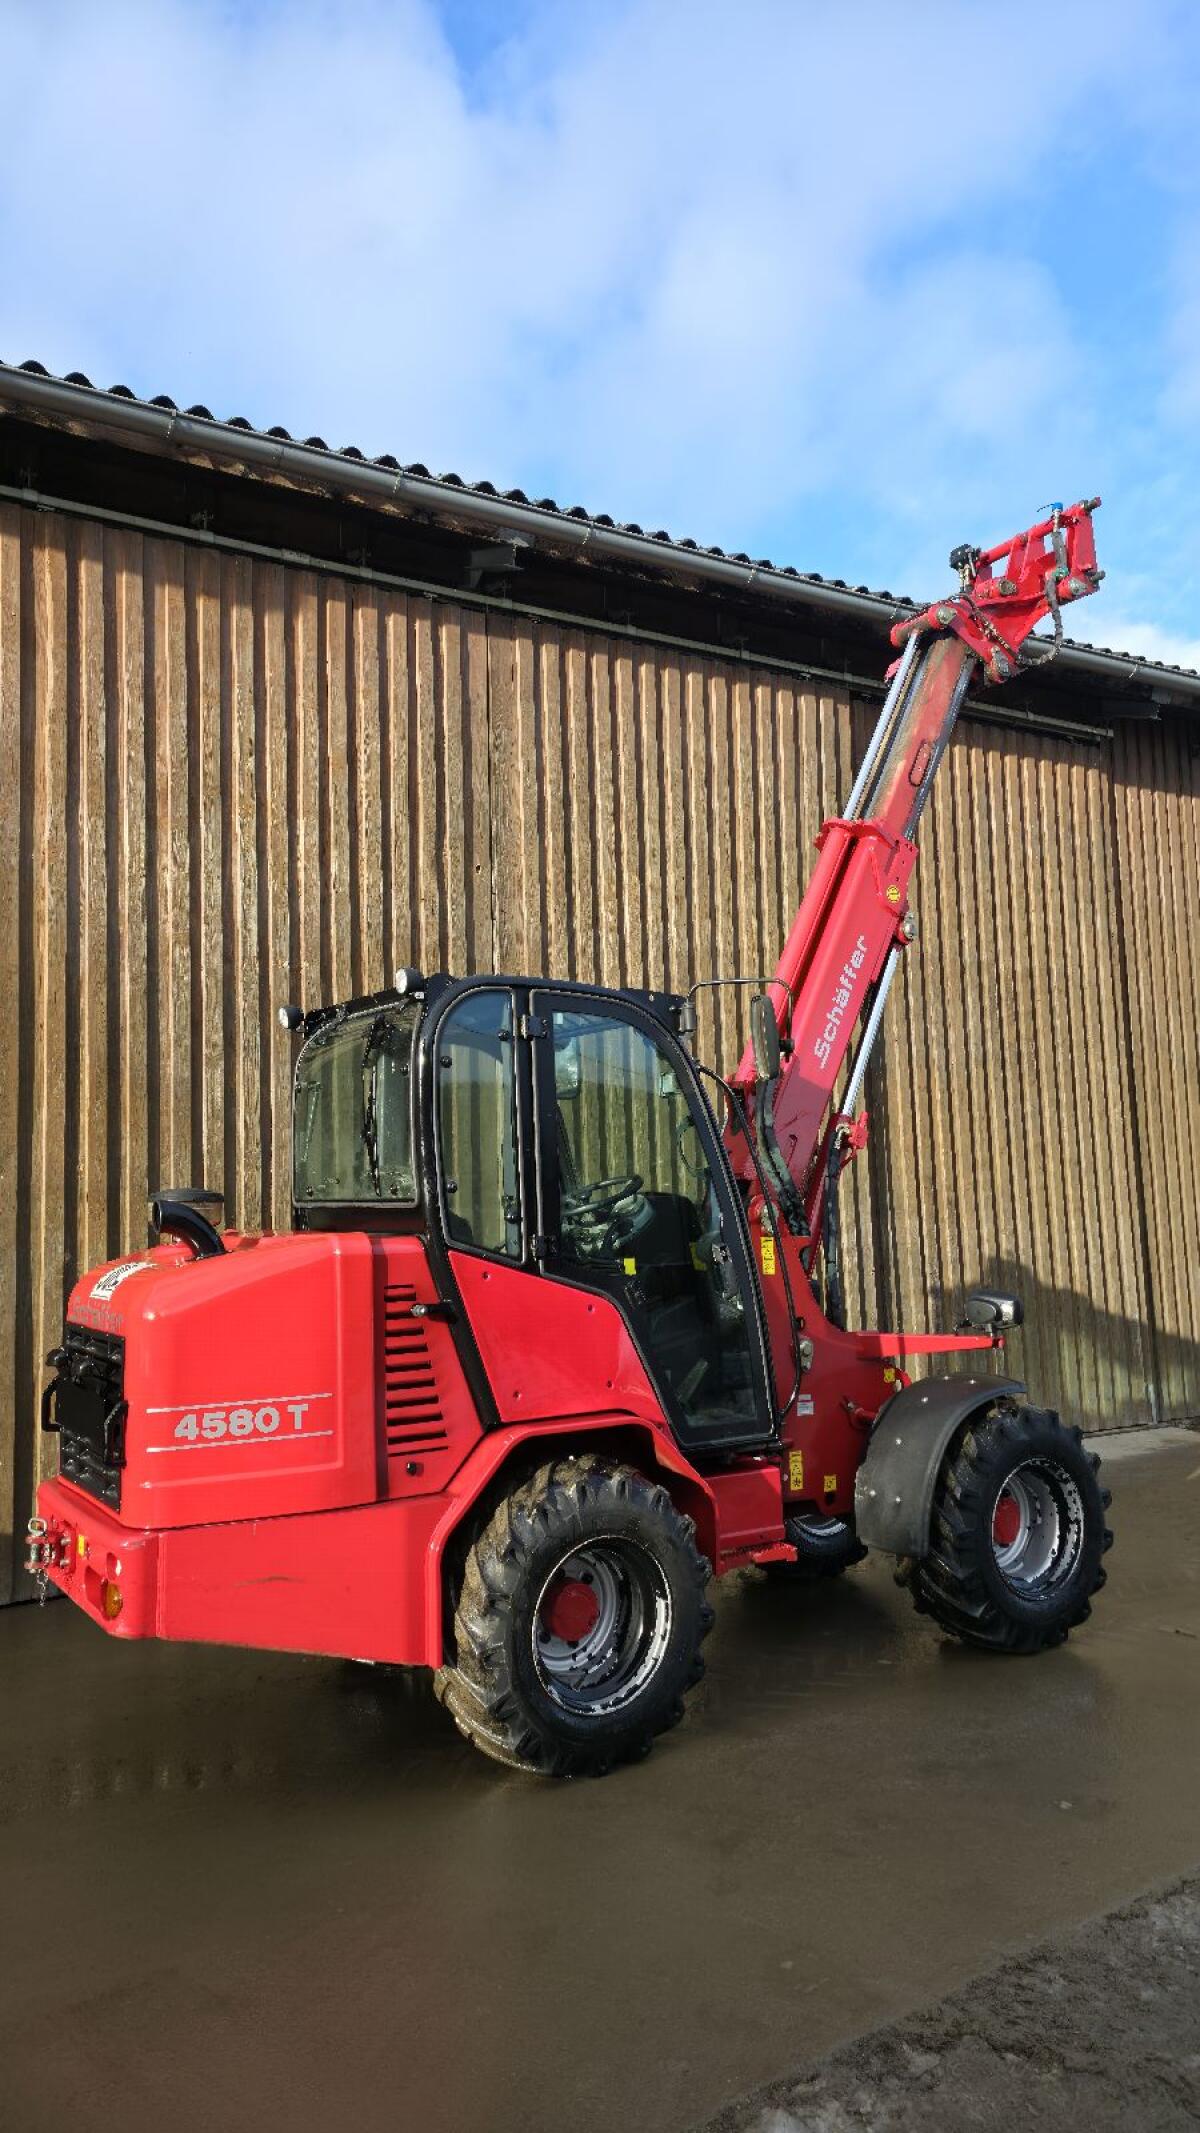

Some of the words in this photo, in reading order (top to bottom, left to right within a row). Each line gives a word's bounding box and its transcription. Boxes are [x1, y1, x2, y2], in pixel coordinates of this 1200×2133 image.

[814, 935, 867, 1069] Schäffer
[174, 1406, 280, 1441] 4580
[287, 1403, 309, 1430] T
